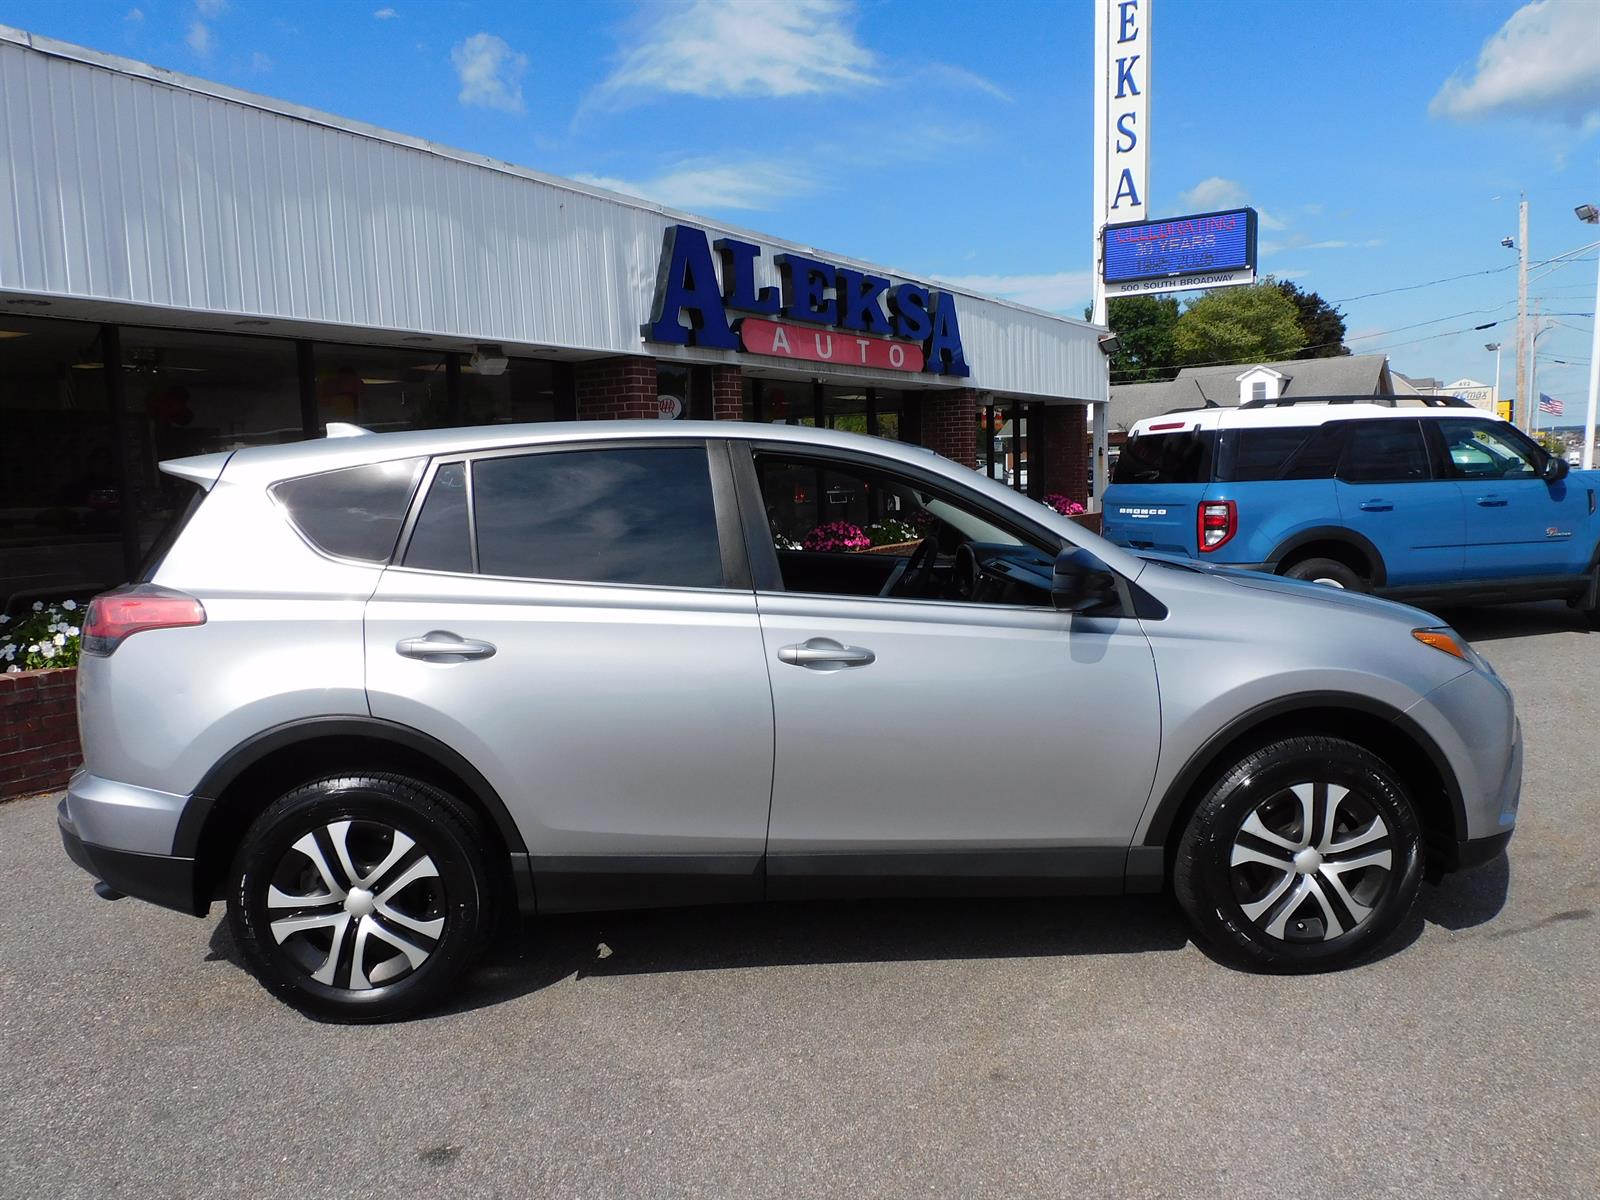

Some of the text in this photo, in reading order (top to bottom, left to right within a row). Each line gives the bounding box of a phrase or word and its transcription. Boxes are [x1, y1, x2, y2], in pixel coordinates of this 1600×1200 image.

[1159, 234, 1216, 252] YEARS
[1143, 280, 1176, 290] SOUTH
[1180, 275, 1234, 286] BROADWAY
[641, 224, 969, 377] ALEKSA
[772, 327, 904, 368] AUTO
